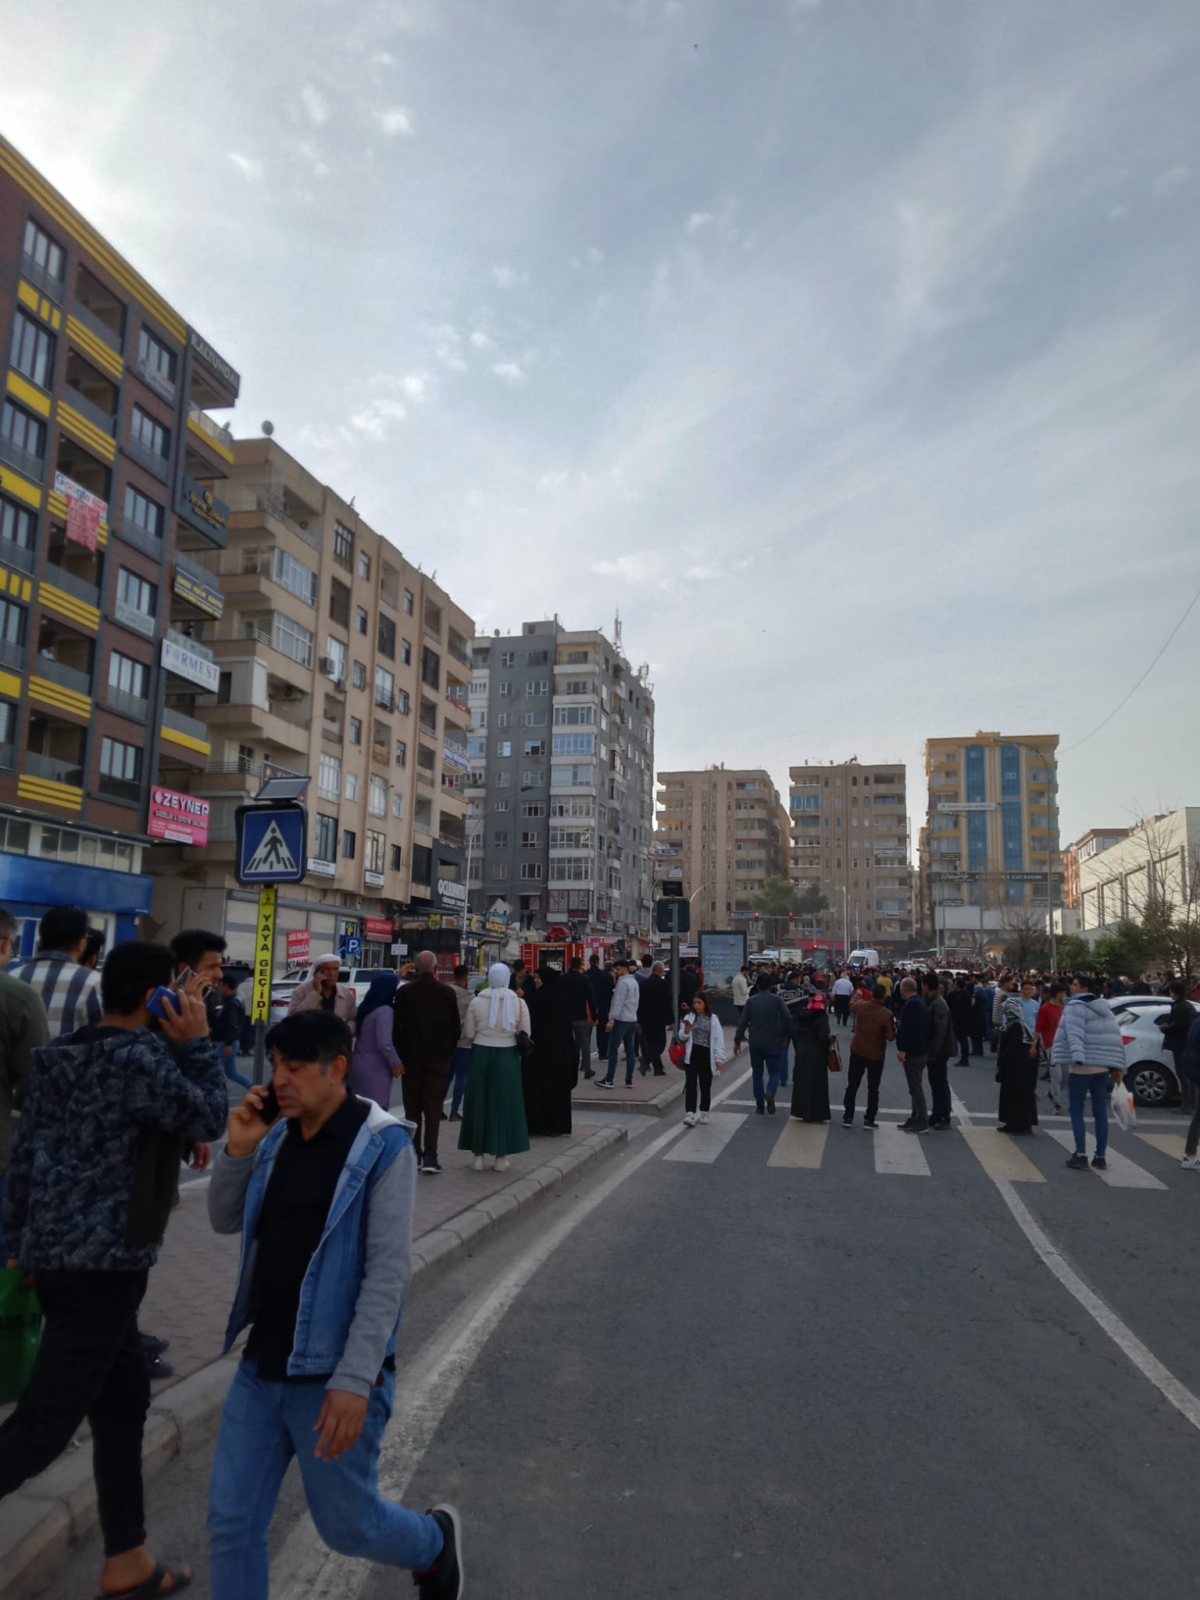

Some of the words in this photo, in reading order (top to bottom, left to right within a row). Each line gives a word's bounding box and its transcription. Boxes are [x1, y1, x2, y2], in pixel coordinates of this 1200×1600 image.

[260, 914, 272, 953] YAYA
[349, 940, 359, 953] P
[256, 959, 270, 1020] GEÇİDİ
